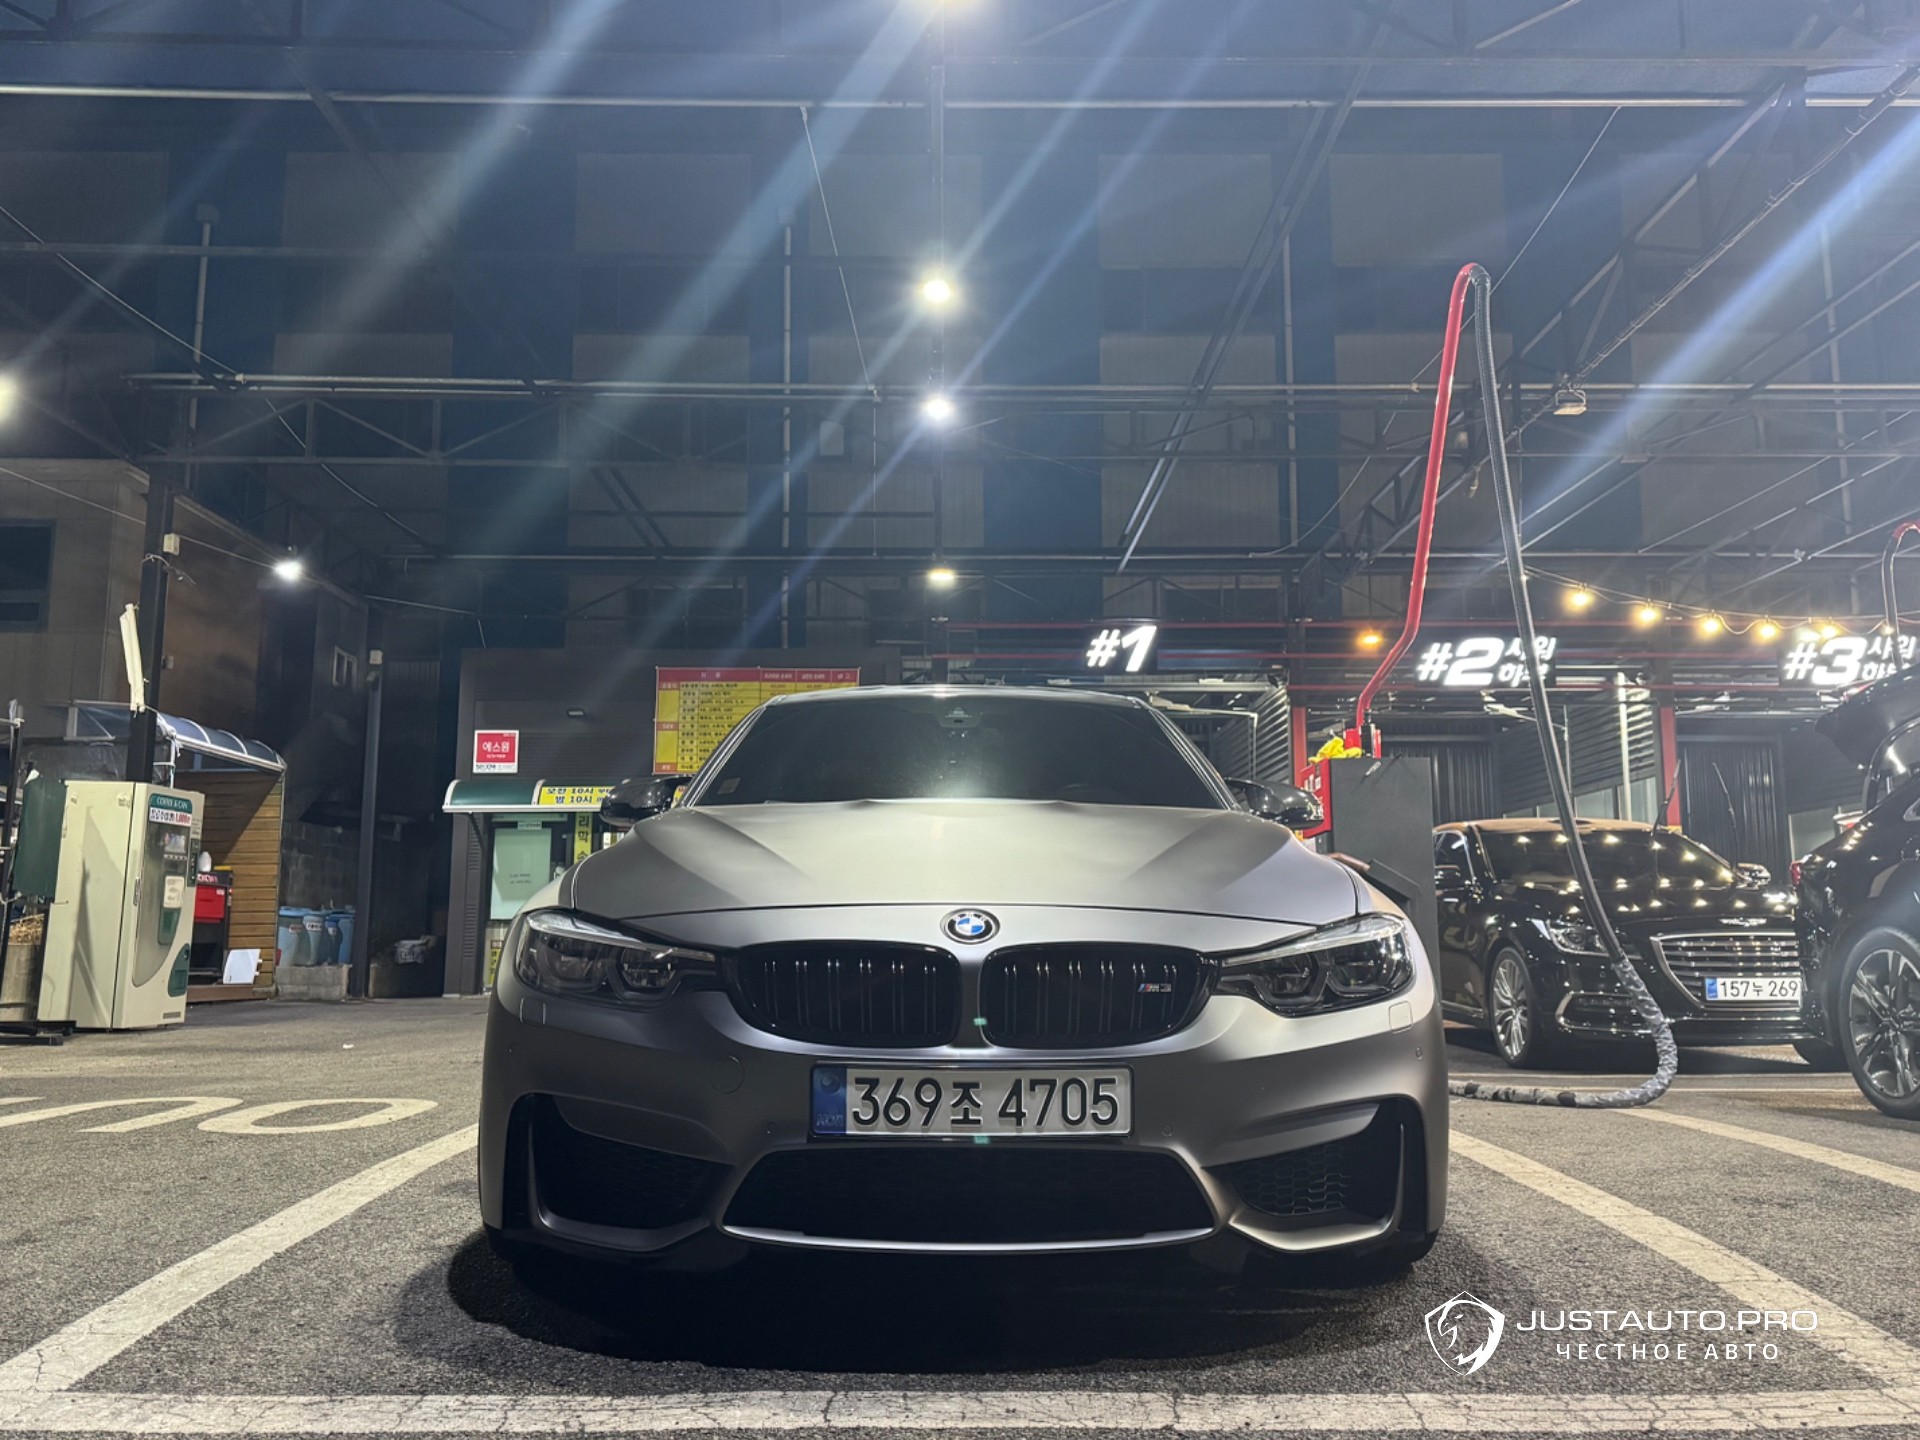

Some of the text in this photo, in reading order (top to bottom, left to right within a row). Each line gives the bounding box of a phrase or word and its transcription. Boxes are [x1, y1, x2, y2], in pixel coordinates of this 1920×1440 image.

[1086, 625, 1157, 672] #1
[1416, 637, 1505, 686] #2
[1783, 637, 1869, 685] #3
[482, 741, 510, 753] 에스원
[1720, 980, 1802, 997] 157누 269
[853, 1078, 1119, 1127] 369조 4705
